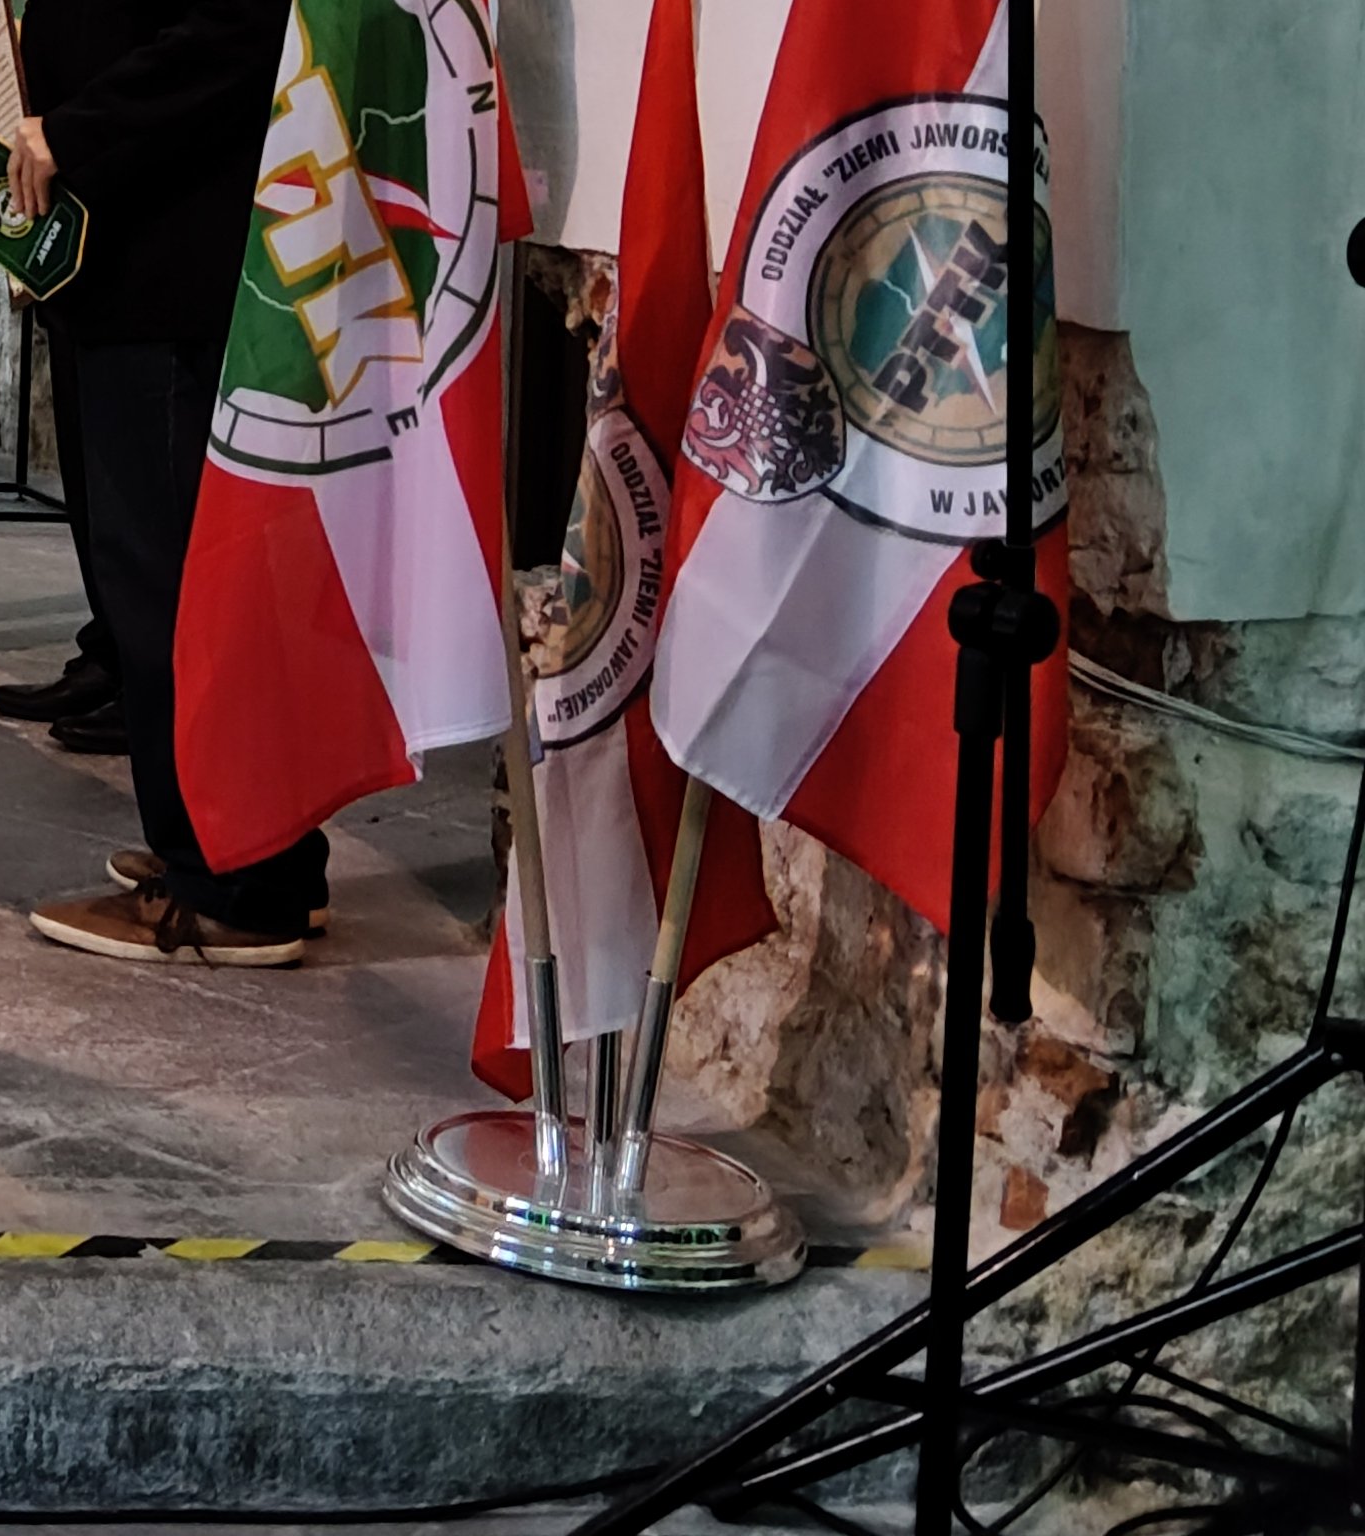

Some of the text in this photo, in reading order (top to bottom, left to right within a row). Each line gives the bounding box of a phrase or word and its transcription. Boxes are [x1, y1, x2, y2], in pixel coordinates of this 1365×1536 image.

[466, 79, 498, 116] N
[760, 184, 830, 282] ODDZIAŁ
[385, 406, 419, 438] E
[610, 441, 662, 540] ODDZIAŁ
[929, 488, 955, 515] W
